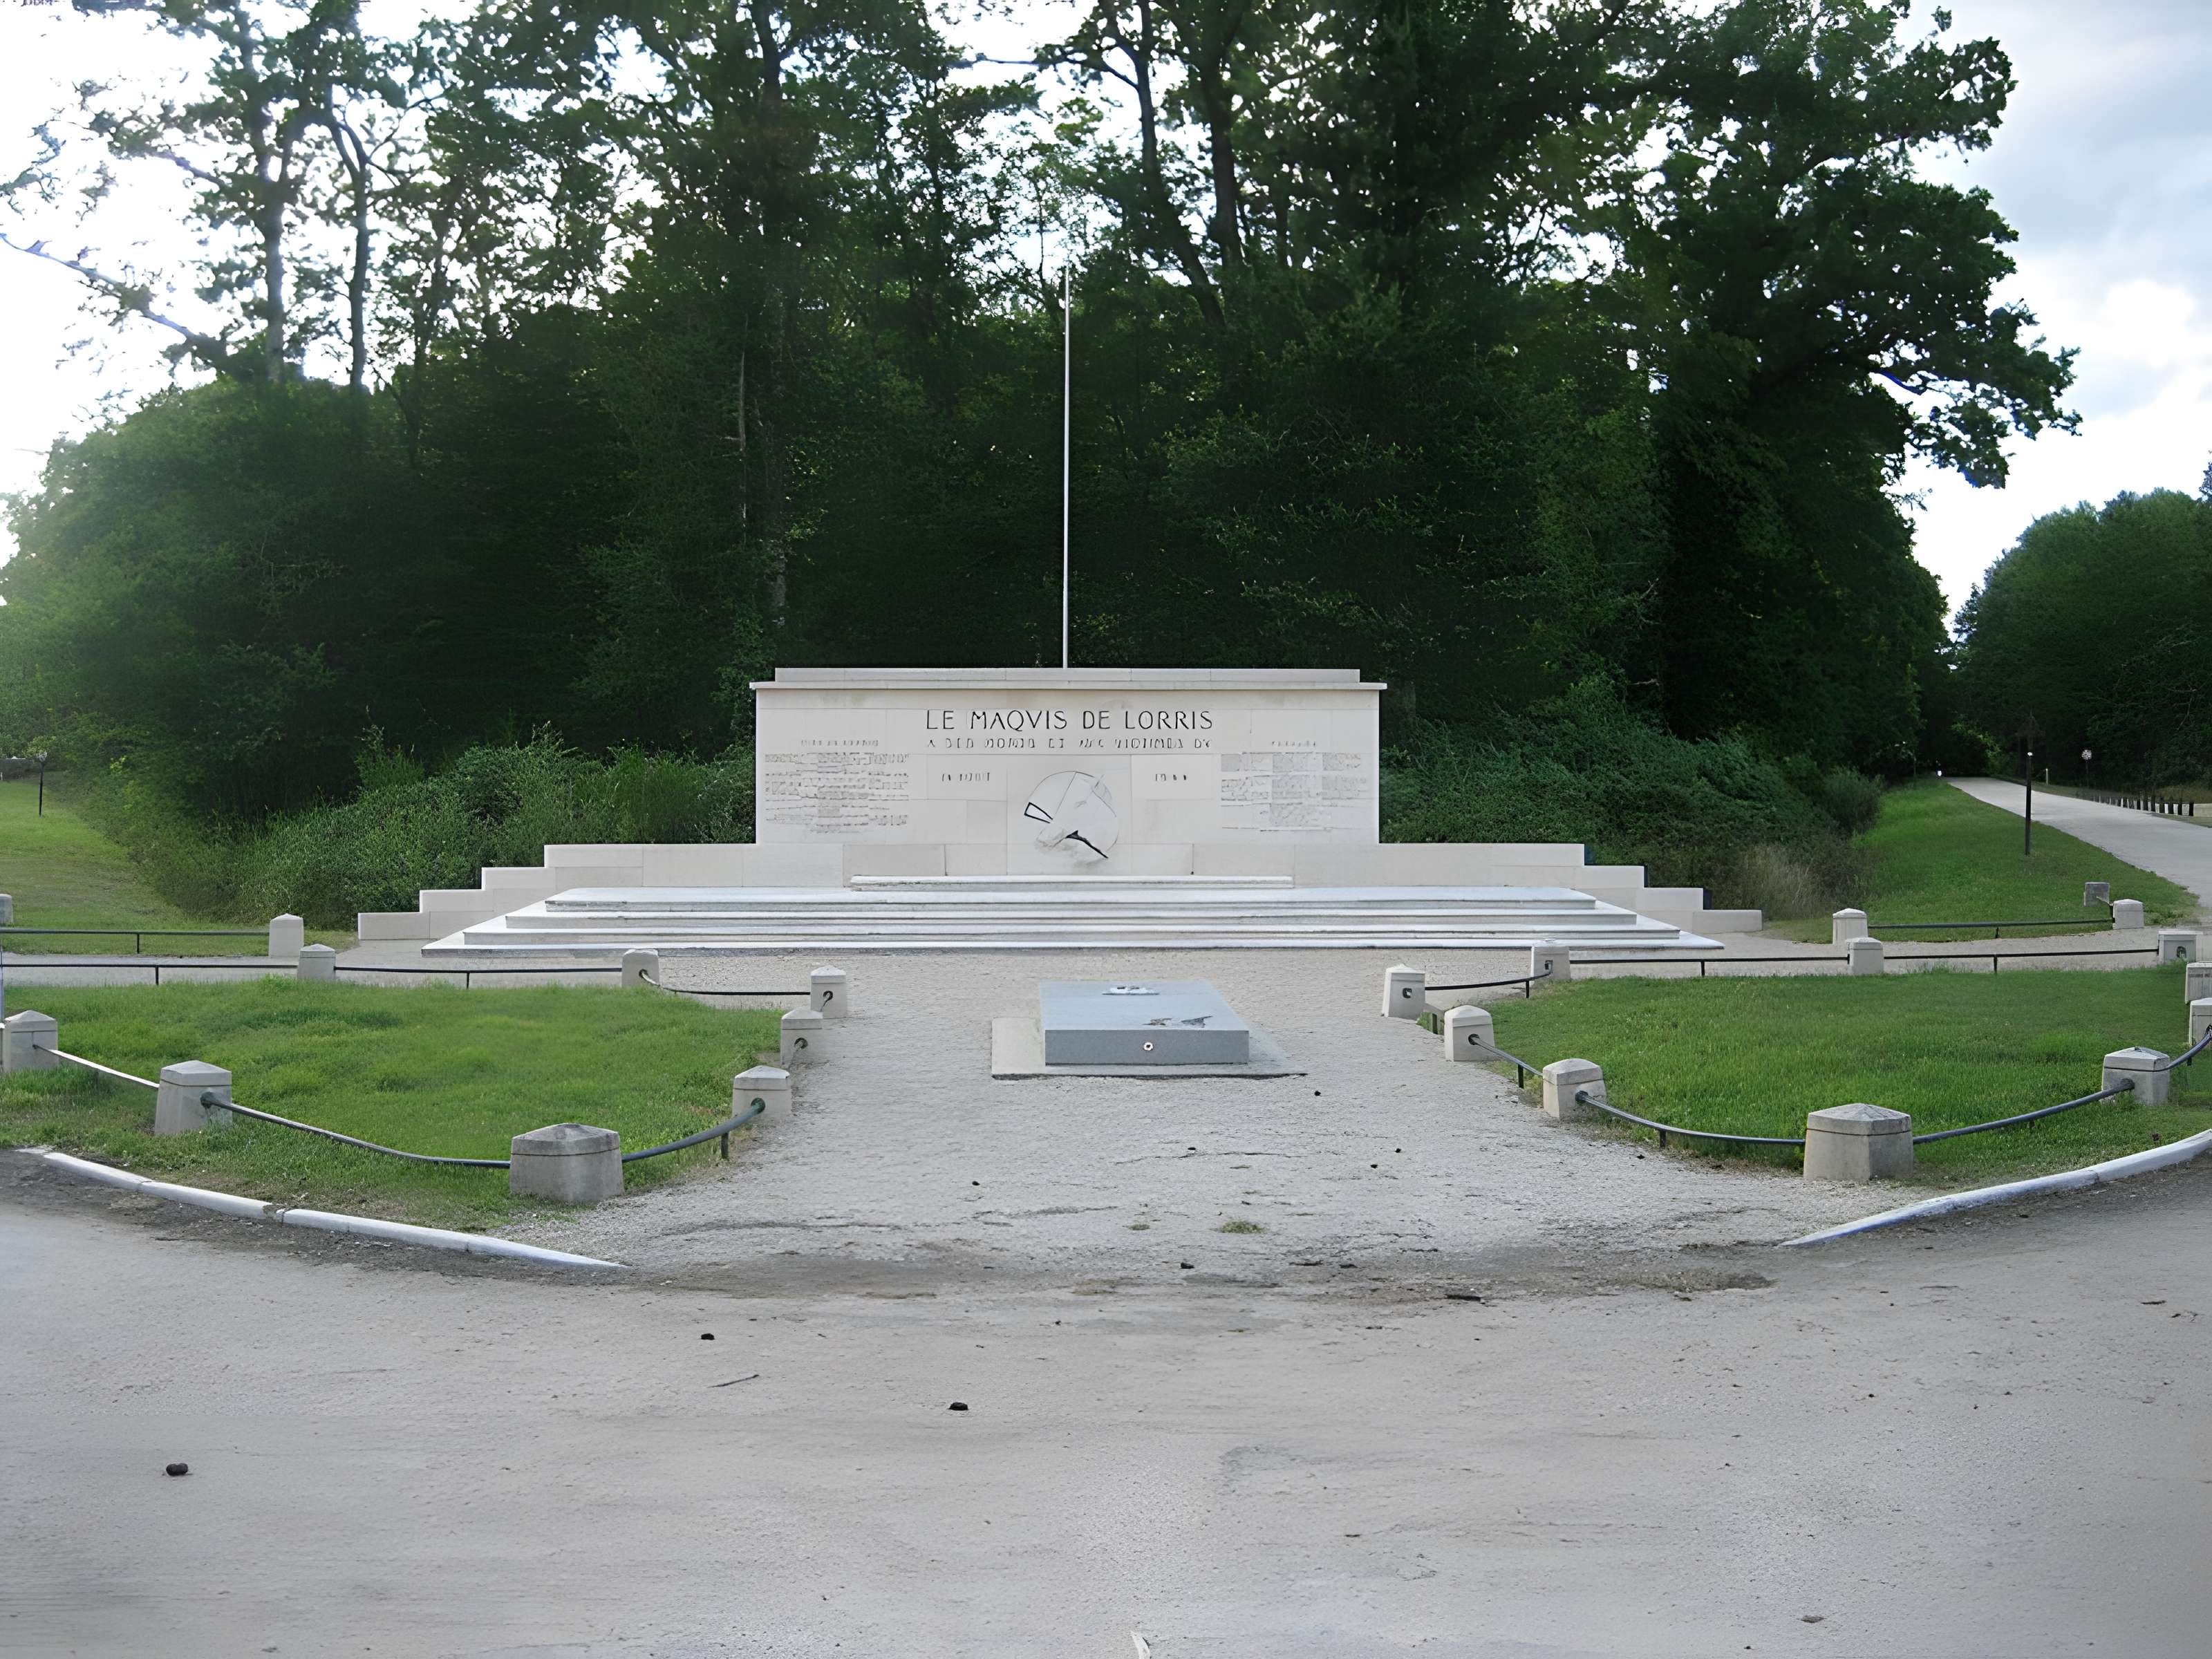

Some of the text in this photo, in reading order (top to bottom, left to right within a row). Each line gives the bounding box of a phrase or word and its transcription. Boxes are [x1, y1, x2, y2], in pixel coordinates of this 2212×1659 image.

[926, 709, 1212, 732] LE MAQVIS DE LORRIS
